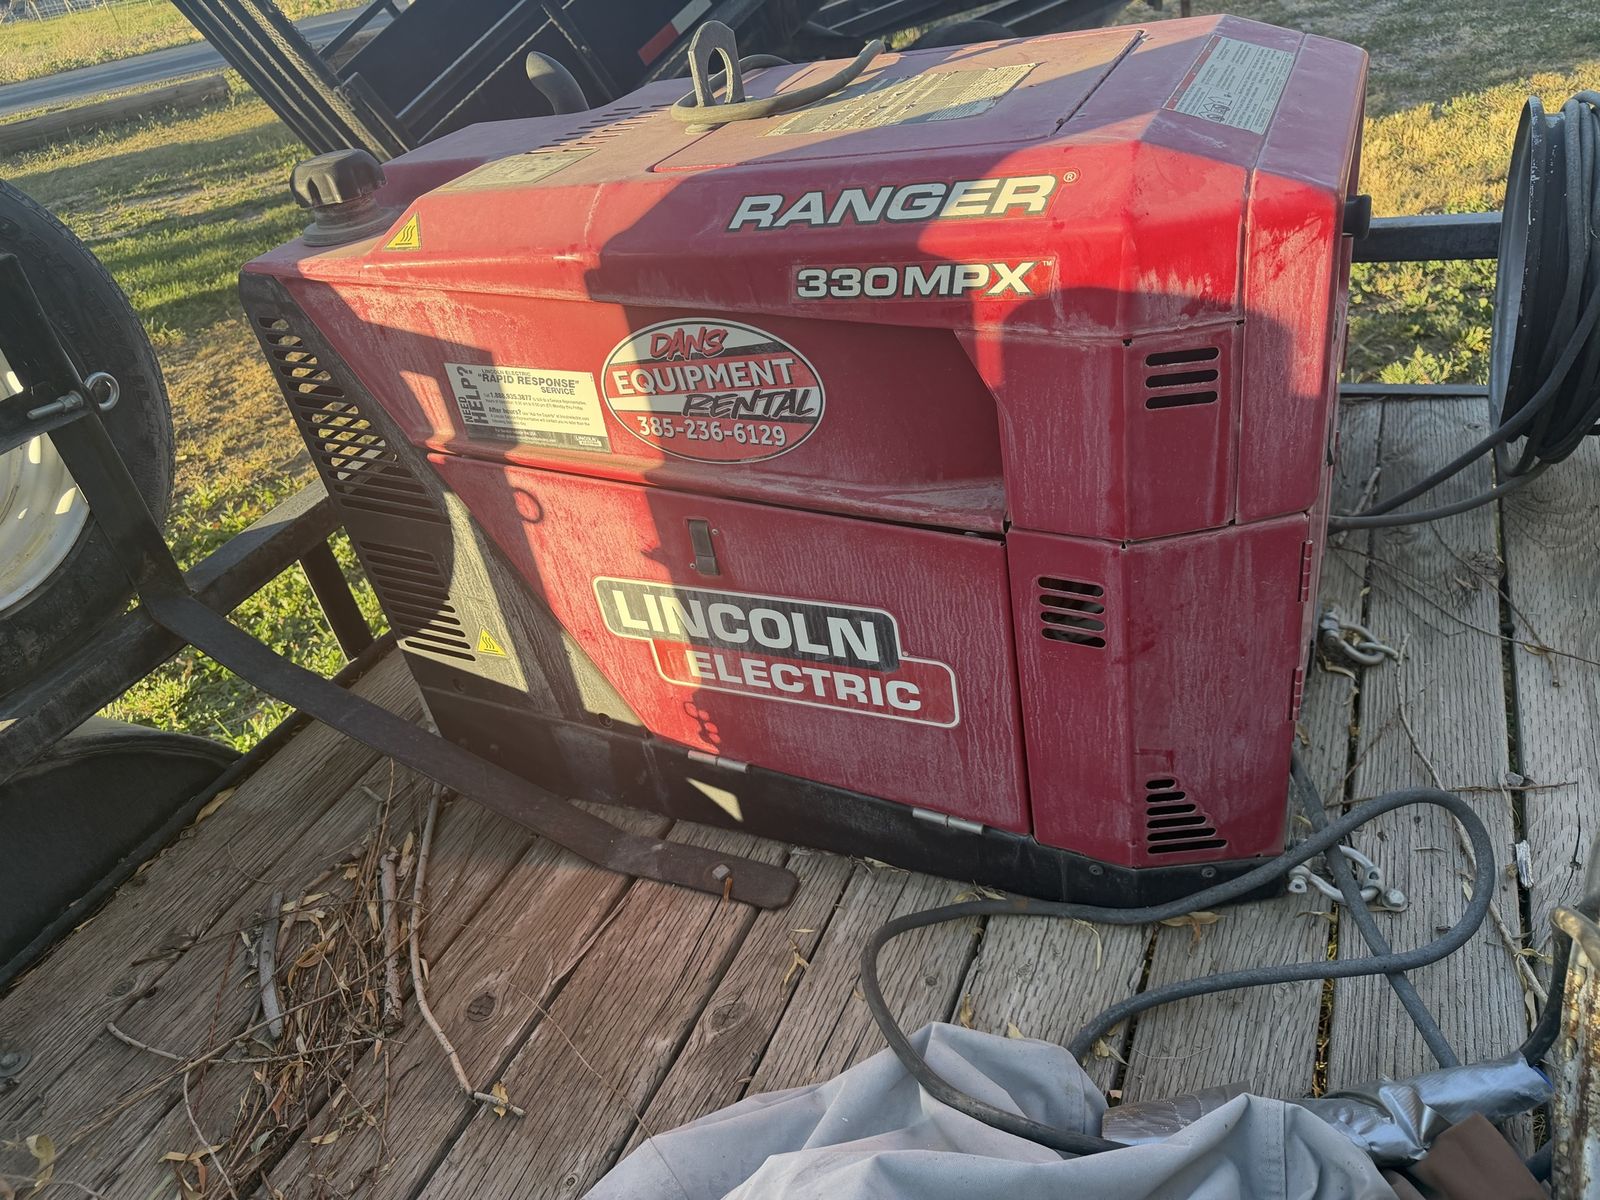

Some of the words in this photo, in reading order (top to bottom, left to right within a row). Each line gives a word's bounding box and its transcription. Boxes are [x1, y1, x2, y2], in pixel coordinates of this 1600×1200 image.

[726, 174, 1057, 231] RANGER
[650, 326, 728, 360] DANS
[541, 386, 575, 396] SERVICE
[612, 358, 795, 395] EQUIPMENT
[457, 366, 489, 424] HELP?
[458, 396, 474, 423] NEED
[682, 388, 814, 419] RENTAL
[637, 415, 786, 447] 385-236-6129
[611, 589, 880, 663] LINCOLN
[685, 649, 921, 711] ELECTRIC
